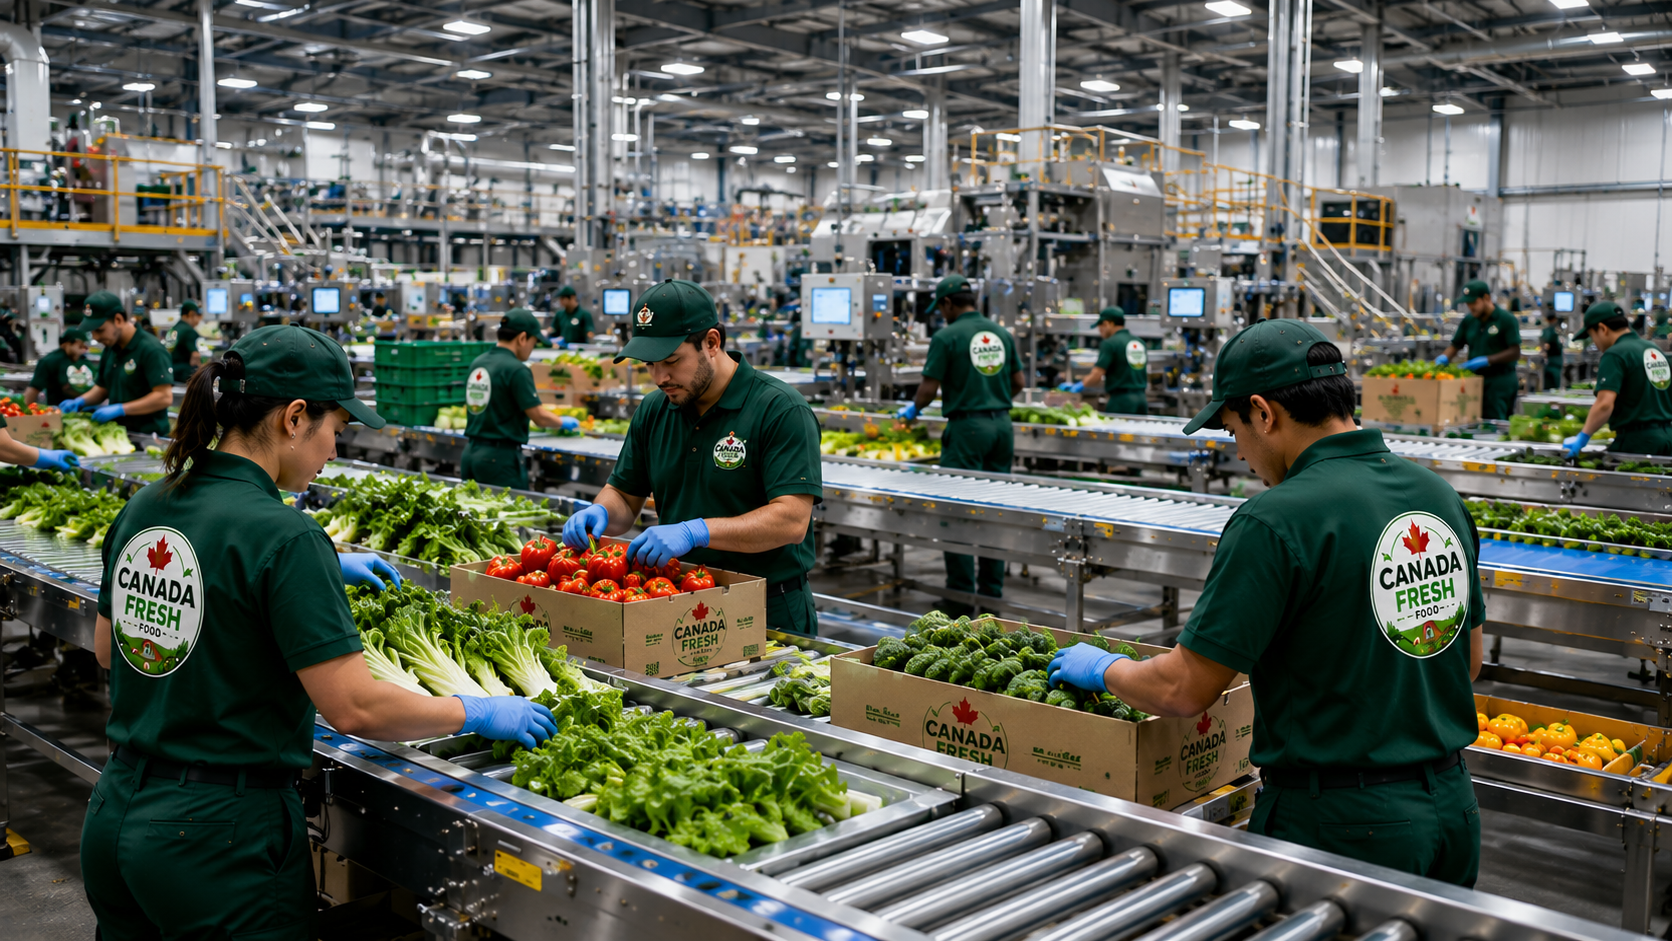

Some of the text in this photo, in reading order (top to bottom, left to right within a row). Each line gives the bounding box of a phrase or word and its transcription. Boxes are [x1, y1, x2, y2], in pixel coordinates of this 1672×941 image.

[1379, 551, 1462, 590] CANADA
[118, 567, 195, 609] CANADA
[1395, 577, 1455, 613] FRESH
[124, 594, 182, 631] FRESH
[138, 623, 161, 638] FOOD
[674, 619, 725, 640] CANADA
[682, 633, 718, 652] FRESH
[926, 719, 1005, 754] CANADA
[1180, 730, 1226, 761] CANADA
[1186, 750, 1218, 775] FRESH
